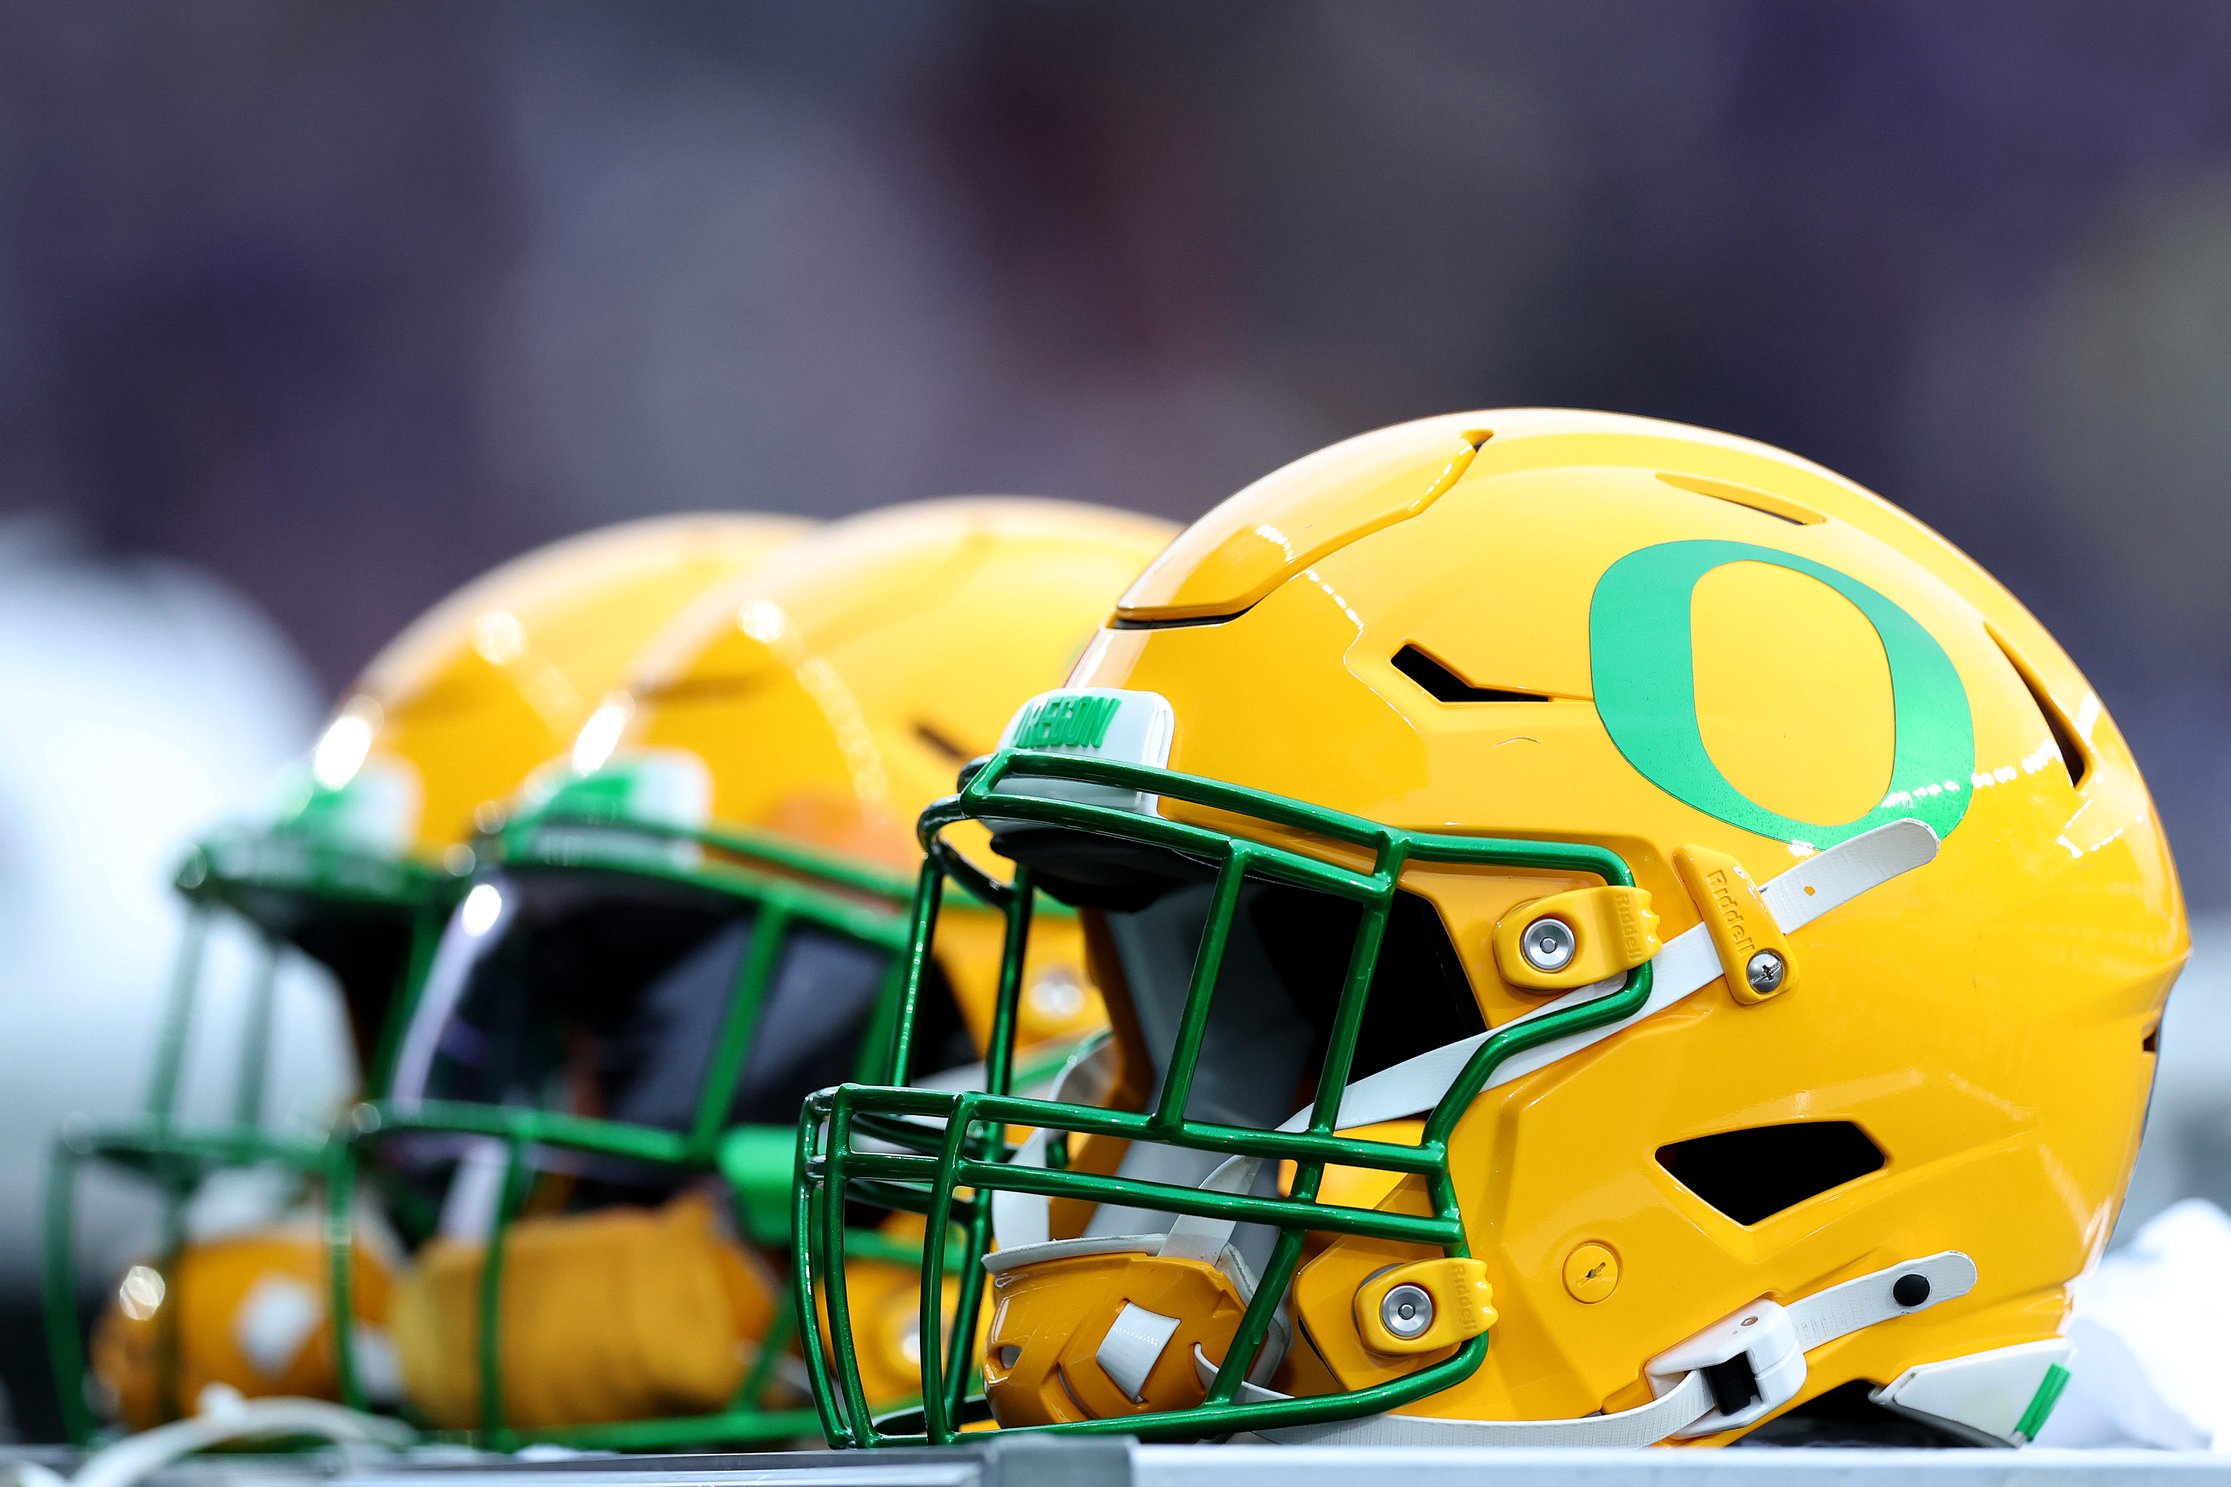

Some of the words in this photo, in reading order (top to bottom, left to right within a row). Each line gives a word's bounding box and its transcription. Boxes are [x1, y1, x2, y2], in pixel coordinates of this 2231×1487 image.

[1589, 539, 1975, 851] O
[1614, 893, 1643, 961] Riddell
[1706, 869, 1756, 958] Riddell
[1450, 1263, 1479, 1332] Riddell
